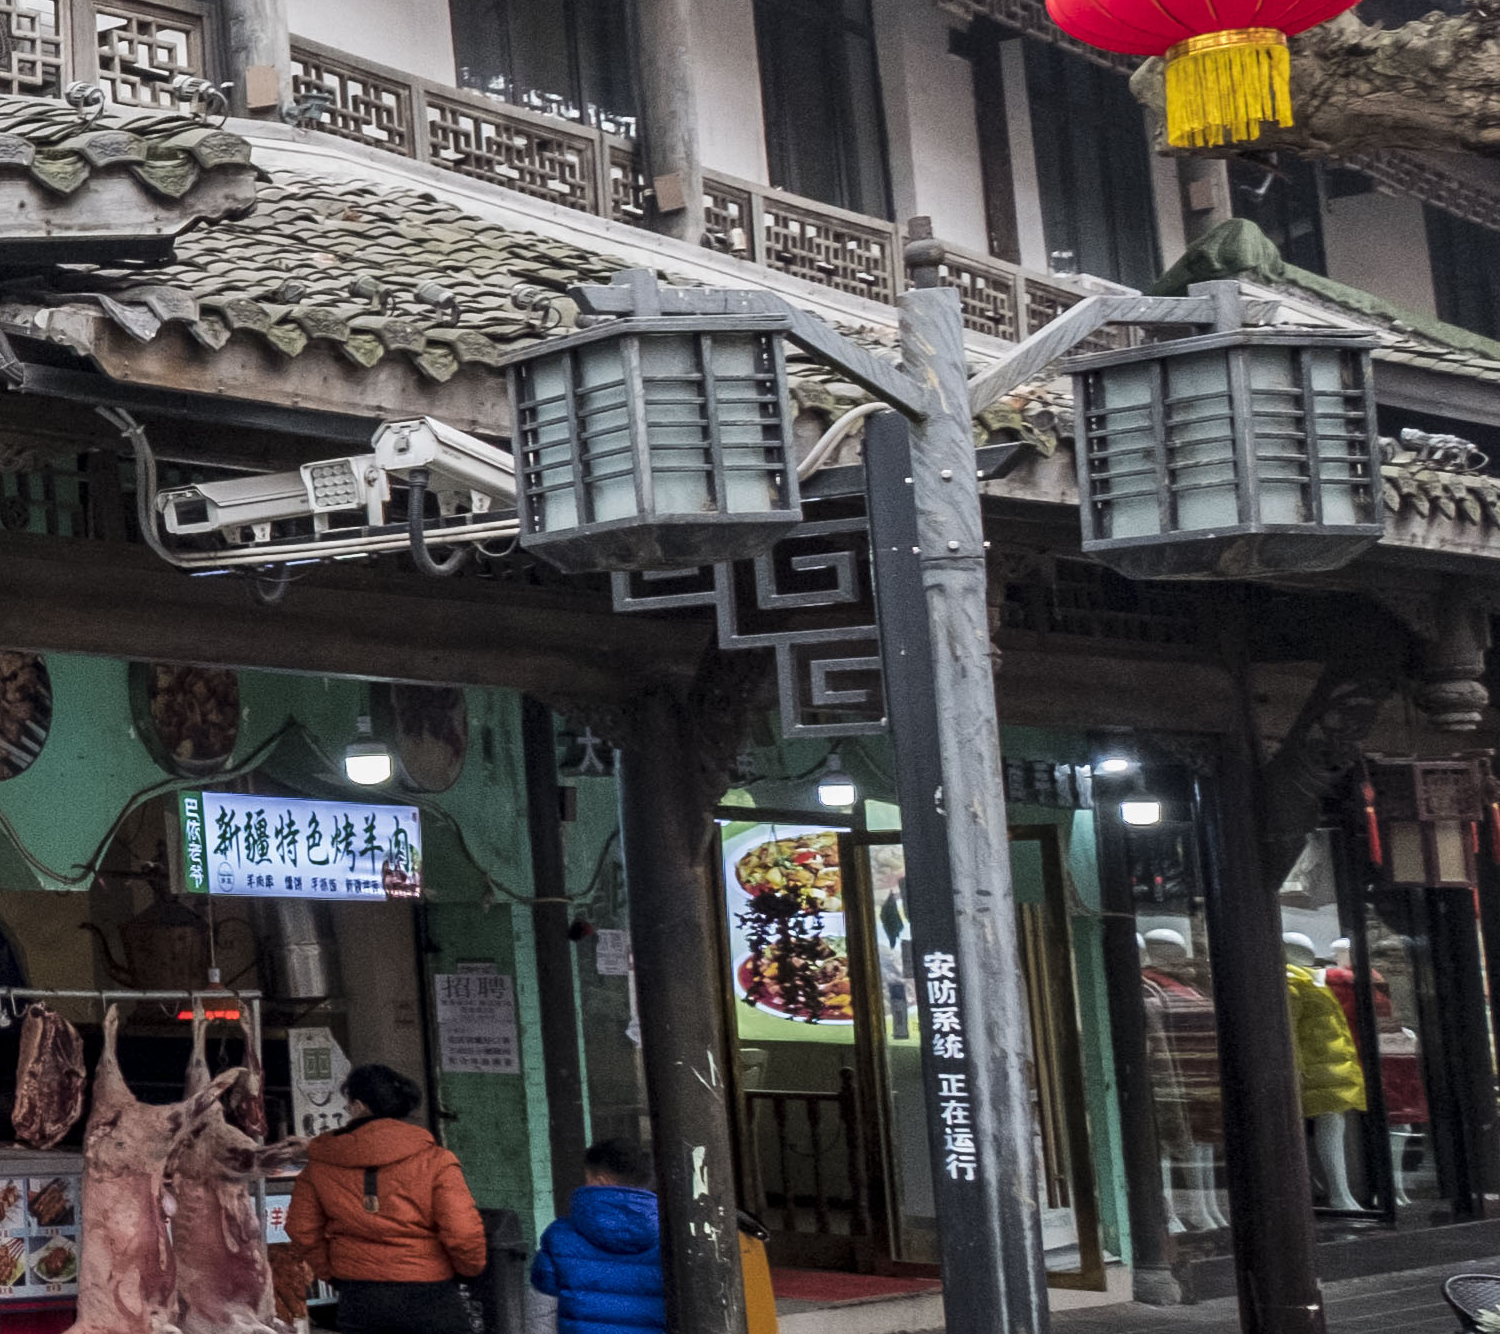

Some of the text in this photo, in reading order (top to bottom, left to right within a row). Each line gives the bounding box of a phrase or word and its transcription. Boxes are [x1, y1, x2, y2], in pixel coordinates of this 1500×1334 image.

[213, 805, 412, 874] 新疆特色烤羊肉
[923, 951, 978, 1181] 安防系统 正在运行
